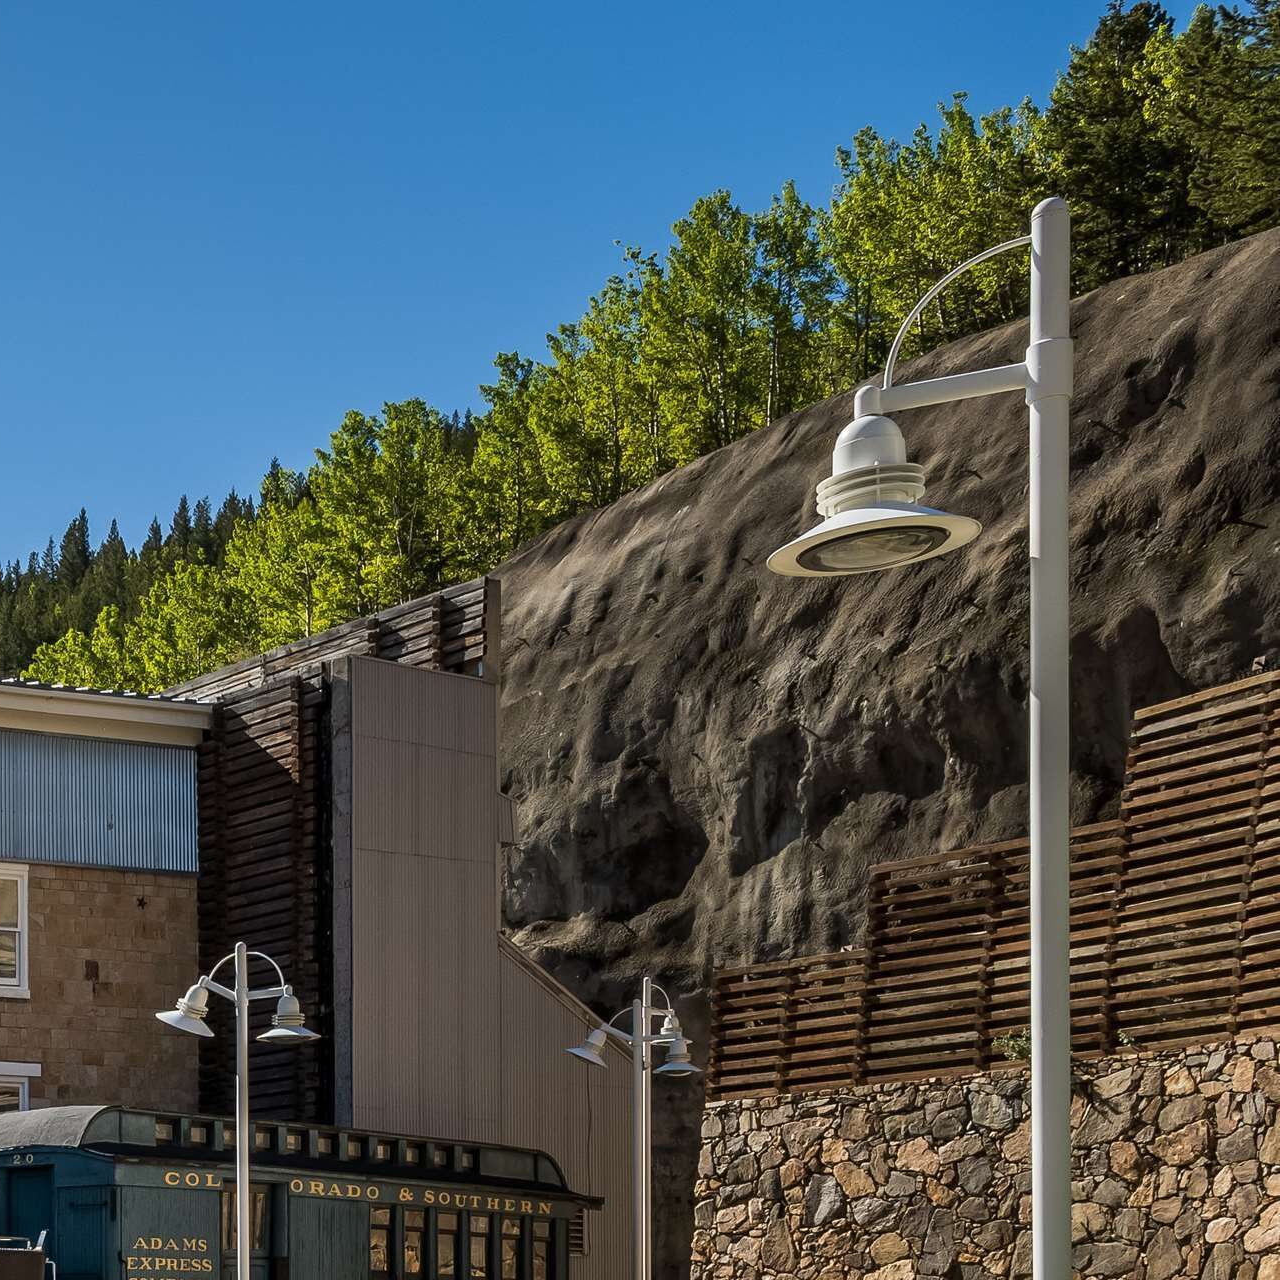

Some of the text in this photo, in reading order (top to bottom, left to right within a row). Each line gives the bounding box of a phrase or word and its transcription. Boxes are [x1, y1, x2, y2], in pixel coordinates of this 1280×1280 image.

[13, 1154, 34, 1165] 20
[398, 1187, 414, 1201] &
[424, 1190, 553, 1214] SOUTHERN
[133, 1237, 207, 1252] ADAMS
[127, 1257, 213, 1272] EXPRESS
